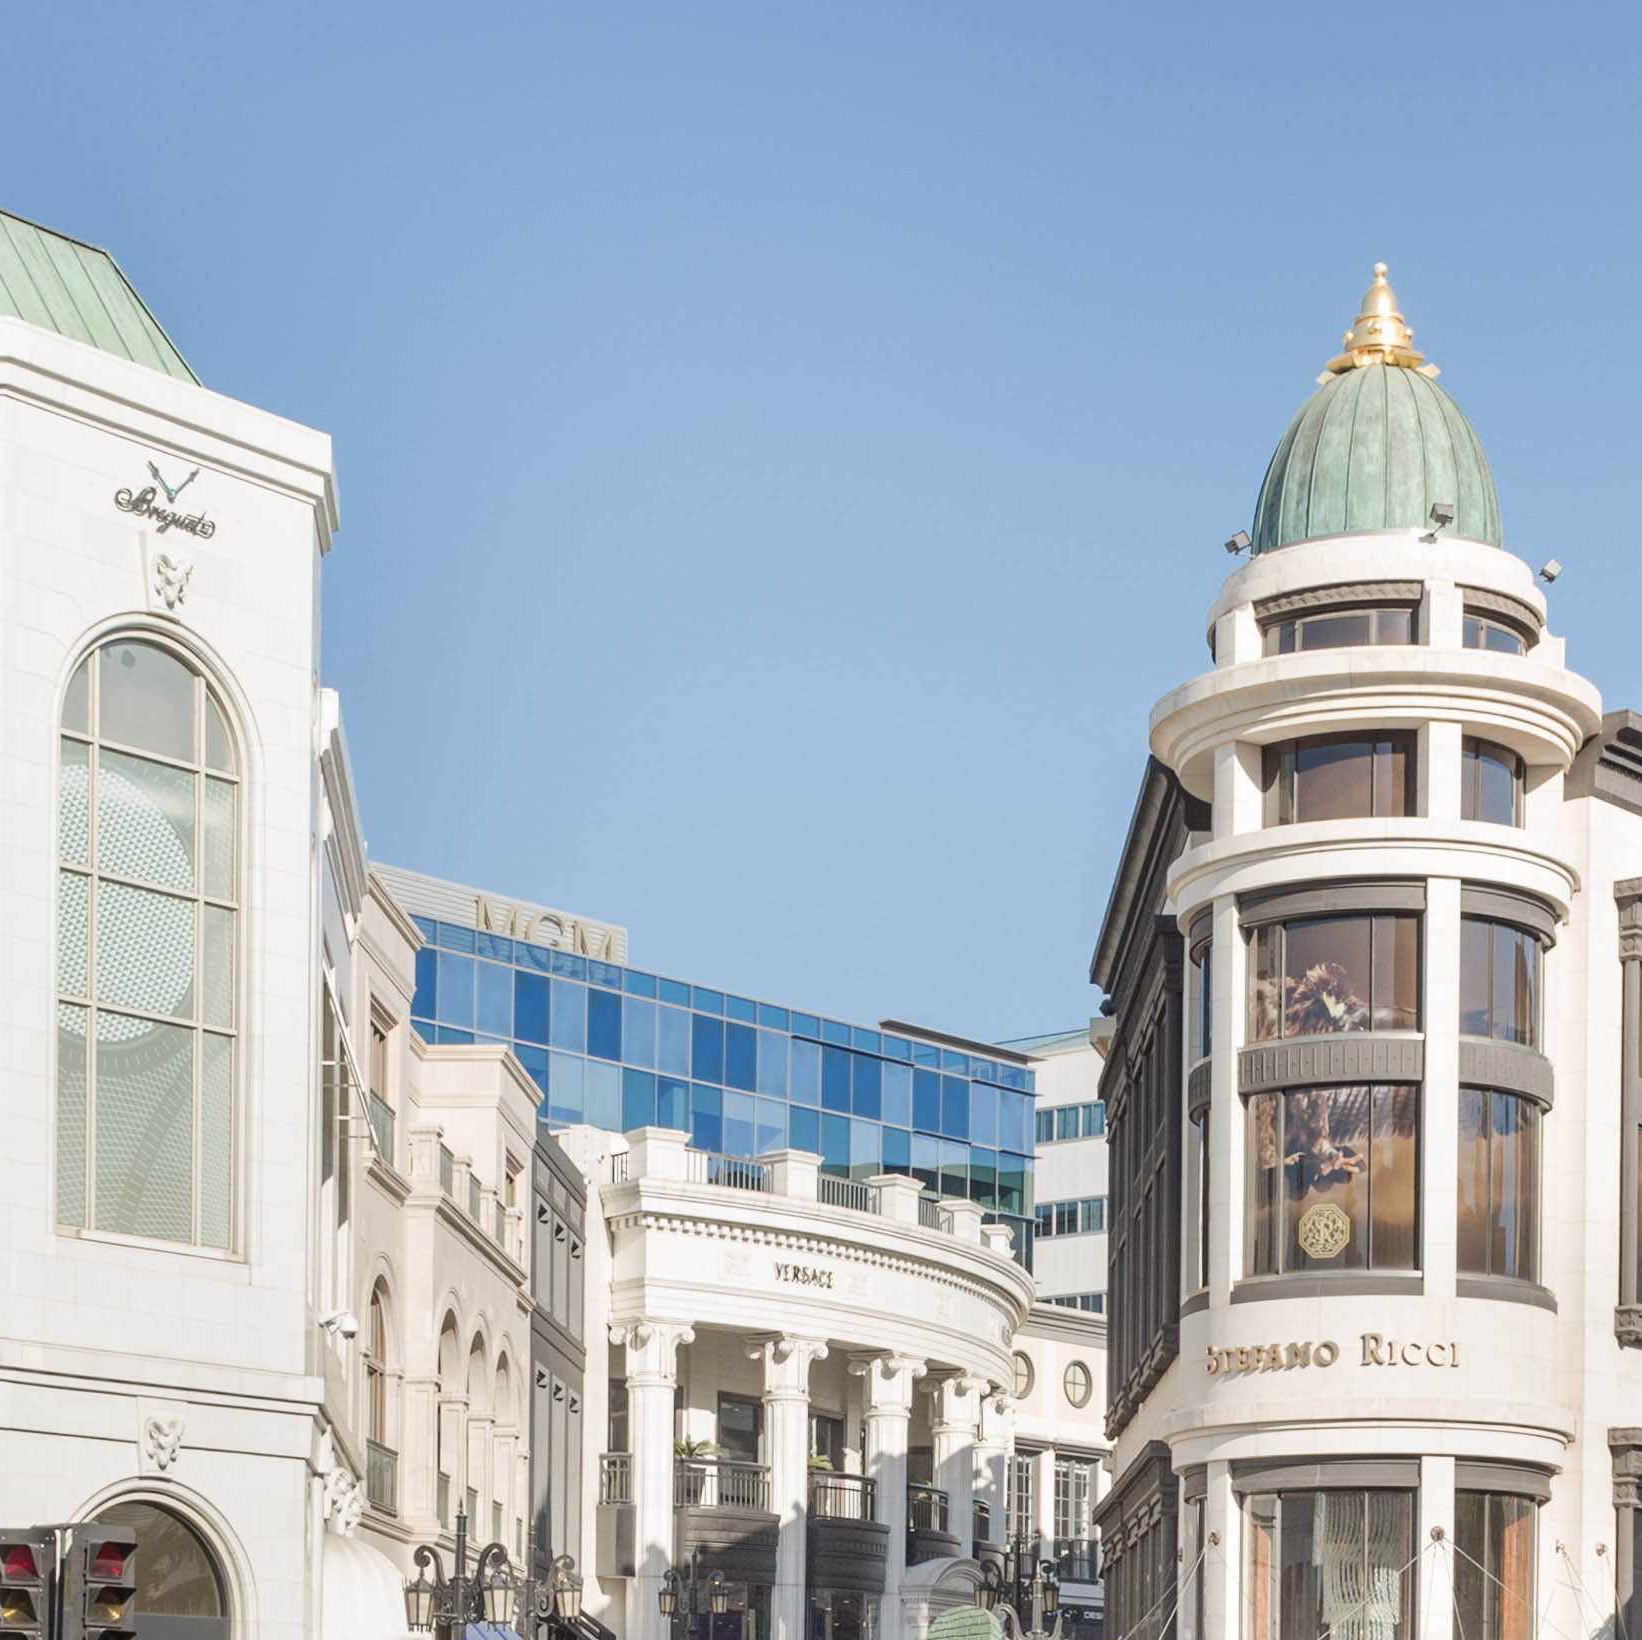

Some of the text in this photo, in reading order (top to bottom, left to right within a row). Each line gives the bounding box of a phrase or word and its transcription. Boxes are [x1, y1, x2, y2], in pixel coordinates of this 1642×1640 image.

[475, 896, 618, 977] MGM
[773, 1261, 833, 1289] VERSACE
[1205, 1332, 1461, 1376] STEFANO RICCI
